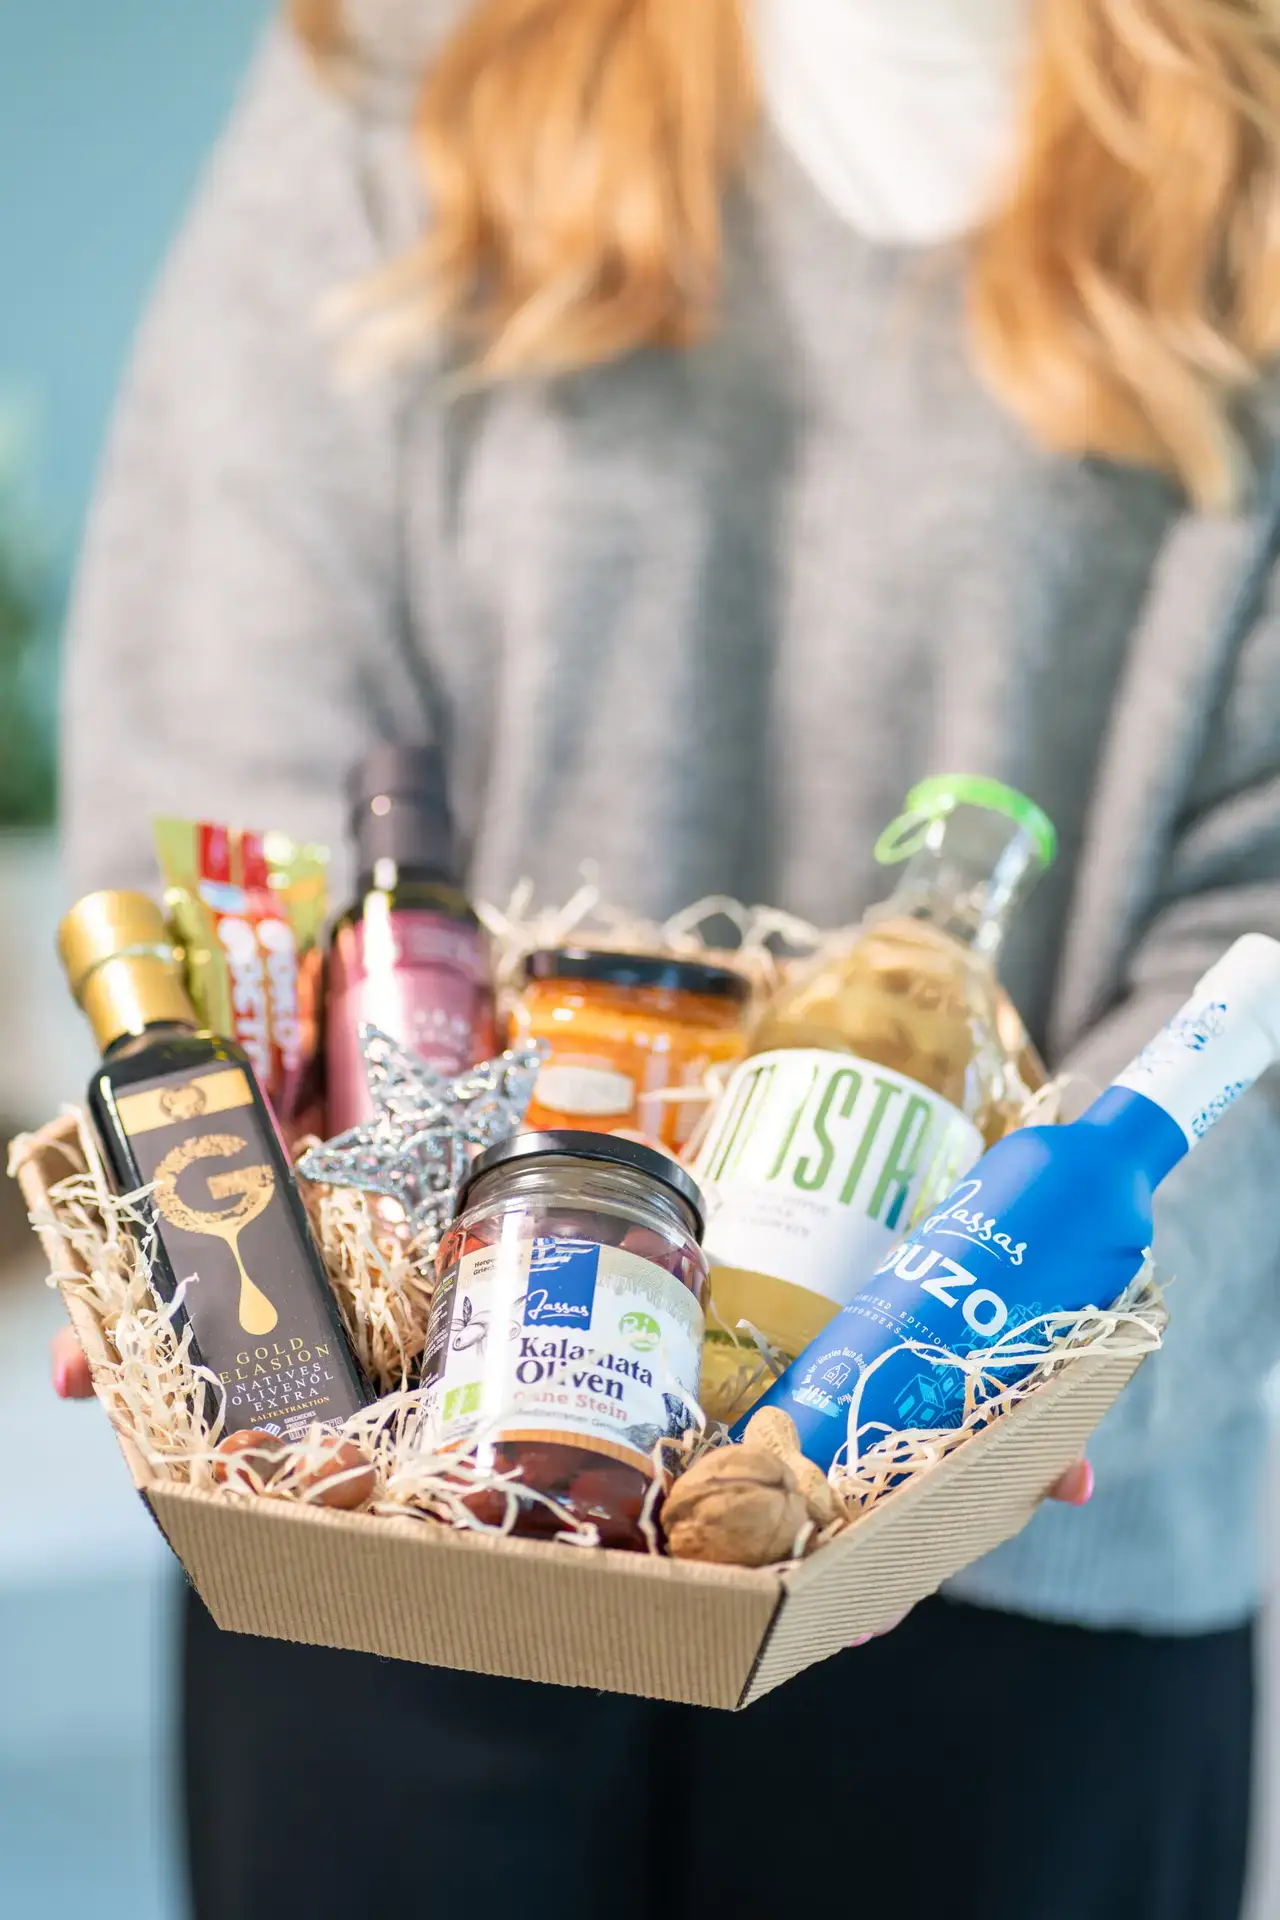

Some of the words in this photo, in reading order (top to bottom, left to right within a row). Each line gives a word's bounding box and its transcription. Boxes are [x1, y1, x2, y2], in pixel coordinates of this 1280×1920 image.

[924, 1179, 1028, 1266] Jassas
[526, 1289, 590, 1320] Jassas
[899, 1311, 951, 1351] EDITION
[218, 1344, 331, 1385] ELASION
[236, 1337, 304, 1365] GOLD
[231, 1371, 334, 1406] OLIVENÖL
[235, 1362, 321, 1394] NATIVES
[250, 1396, 330, 1423] KALTEXTRAKTION
[253, 1387, 320, 1412] EXTRA
[575, 1394, 628, 1422] Stein
